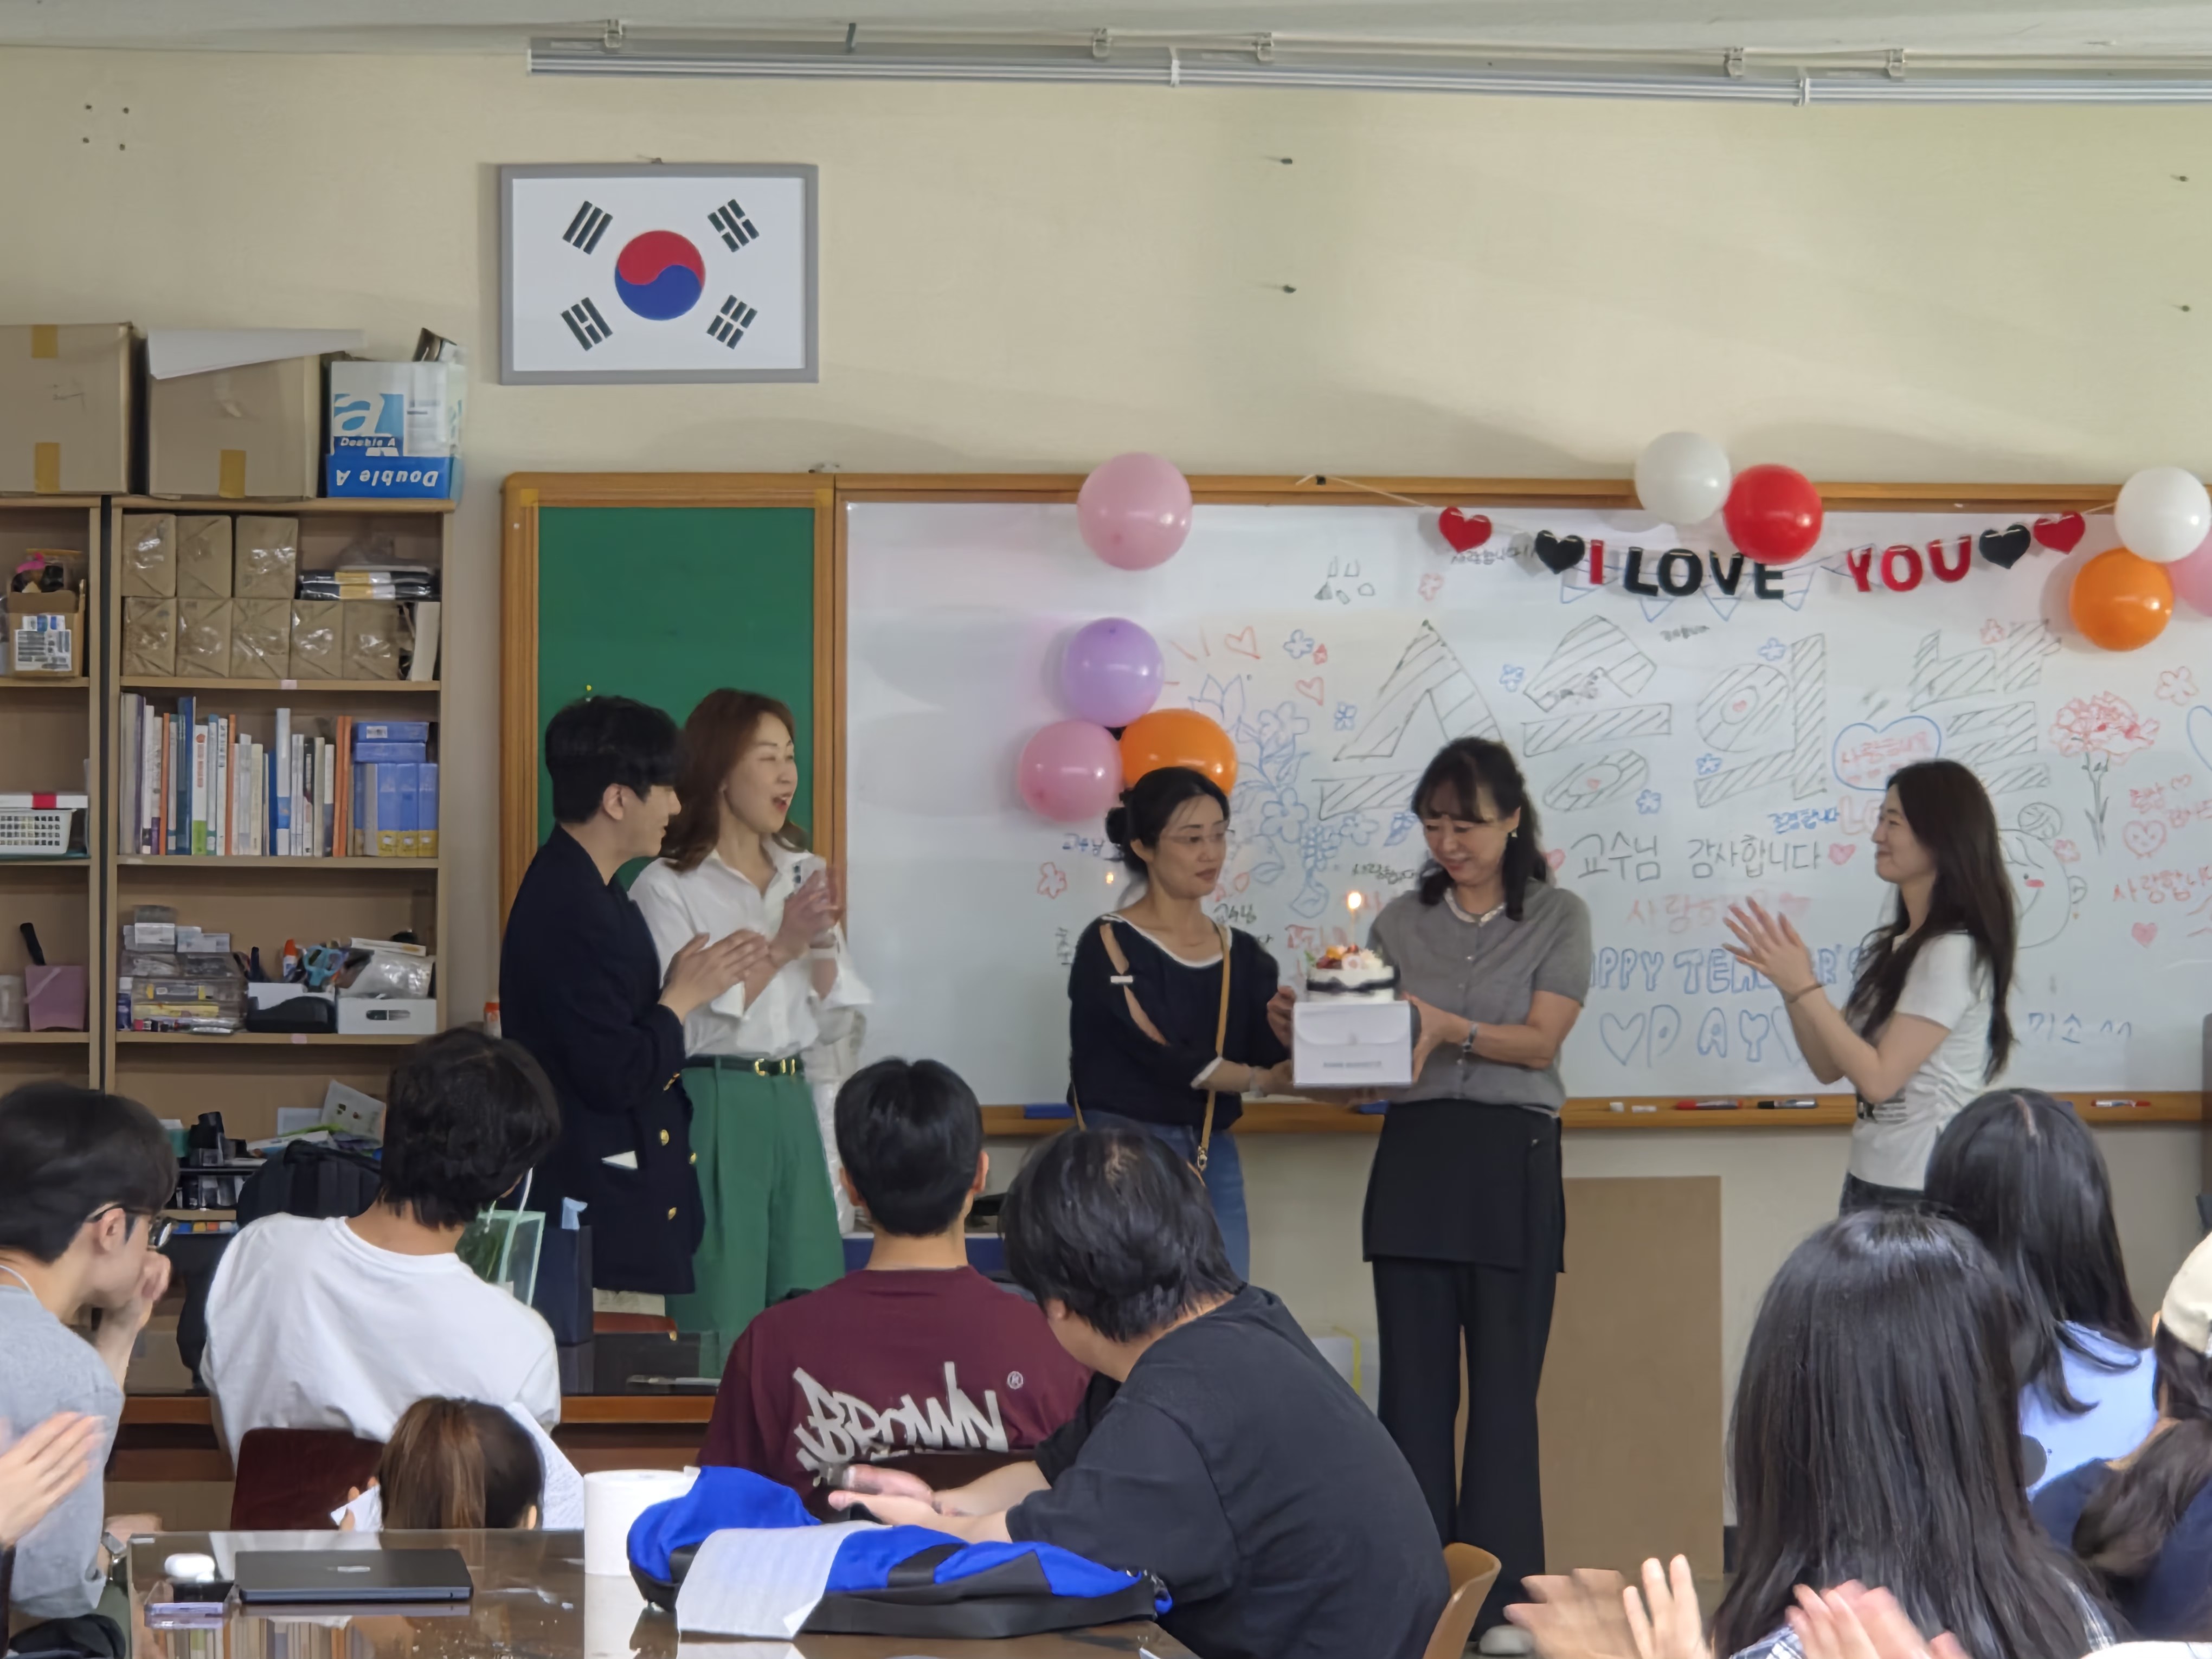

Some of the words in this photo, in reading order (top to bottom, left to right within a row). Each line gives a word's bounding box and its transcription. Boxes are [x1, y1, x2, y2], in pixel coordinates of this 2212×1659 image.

[387, 437, 395, 447] A
[336, 469, 351, 486] A
[359, 470, 439, 487] Double
[1590, 539, 1605, 585] I
[1623, 546, 1784, 600] LOVE
[1847, 535, 1972, 593] YOU
[1571, 831, 1661, 882] 교수님
[1687, 833, 1821, 879] 감사합니다
[1648, 1004, 1771, 1068] DAY
